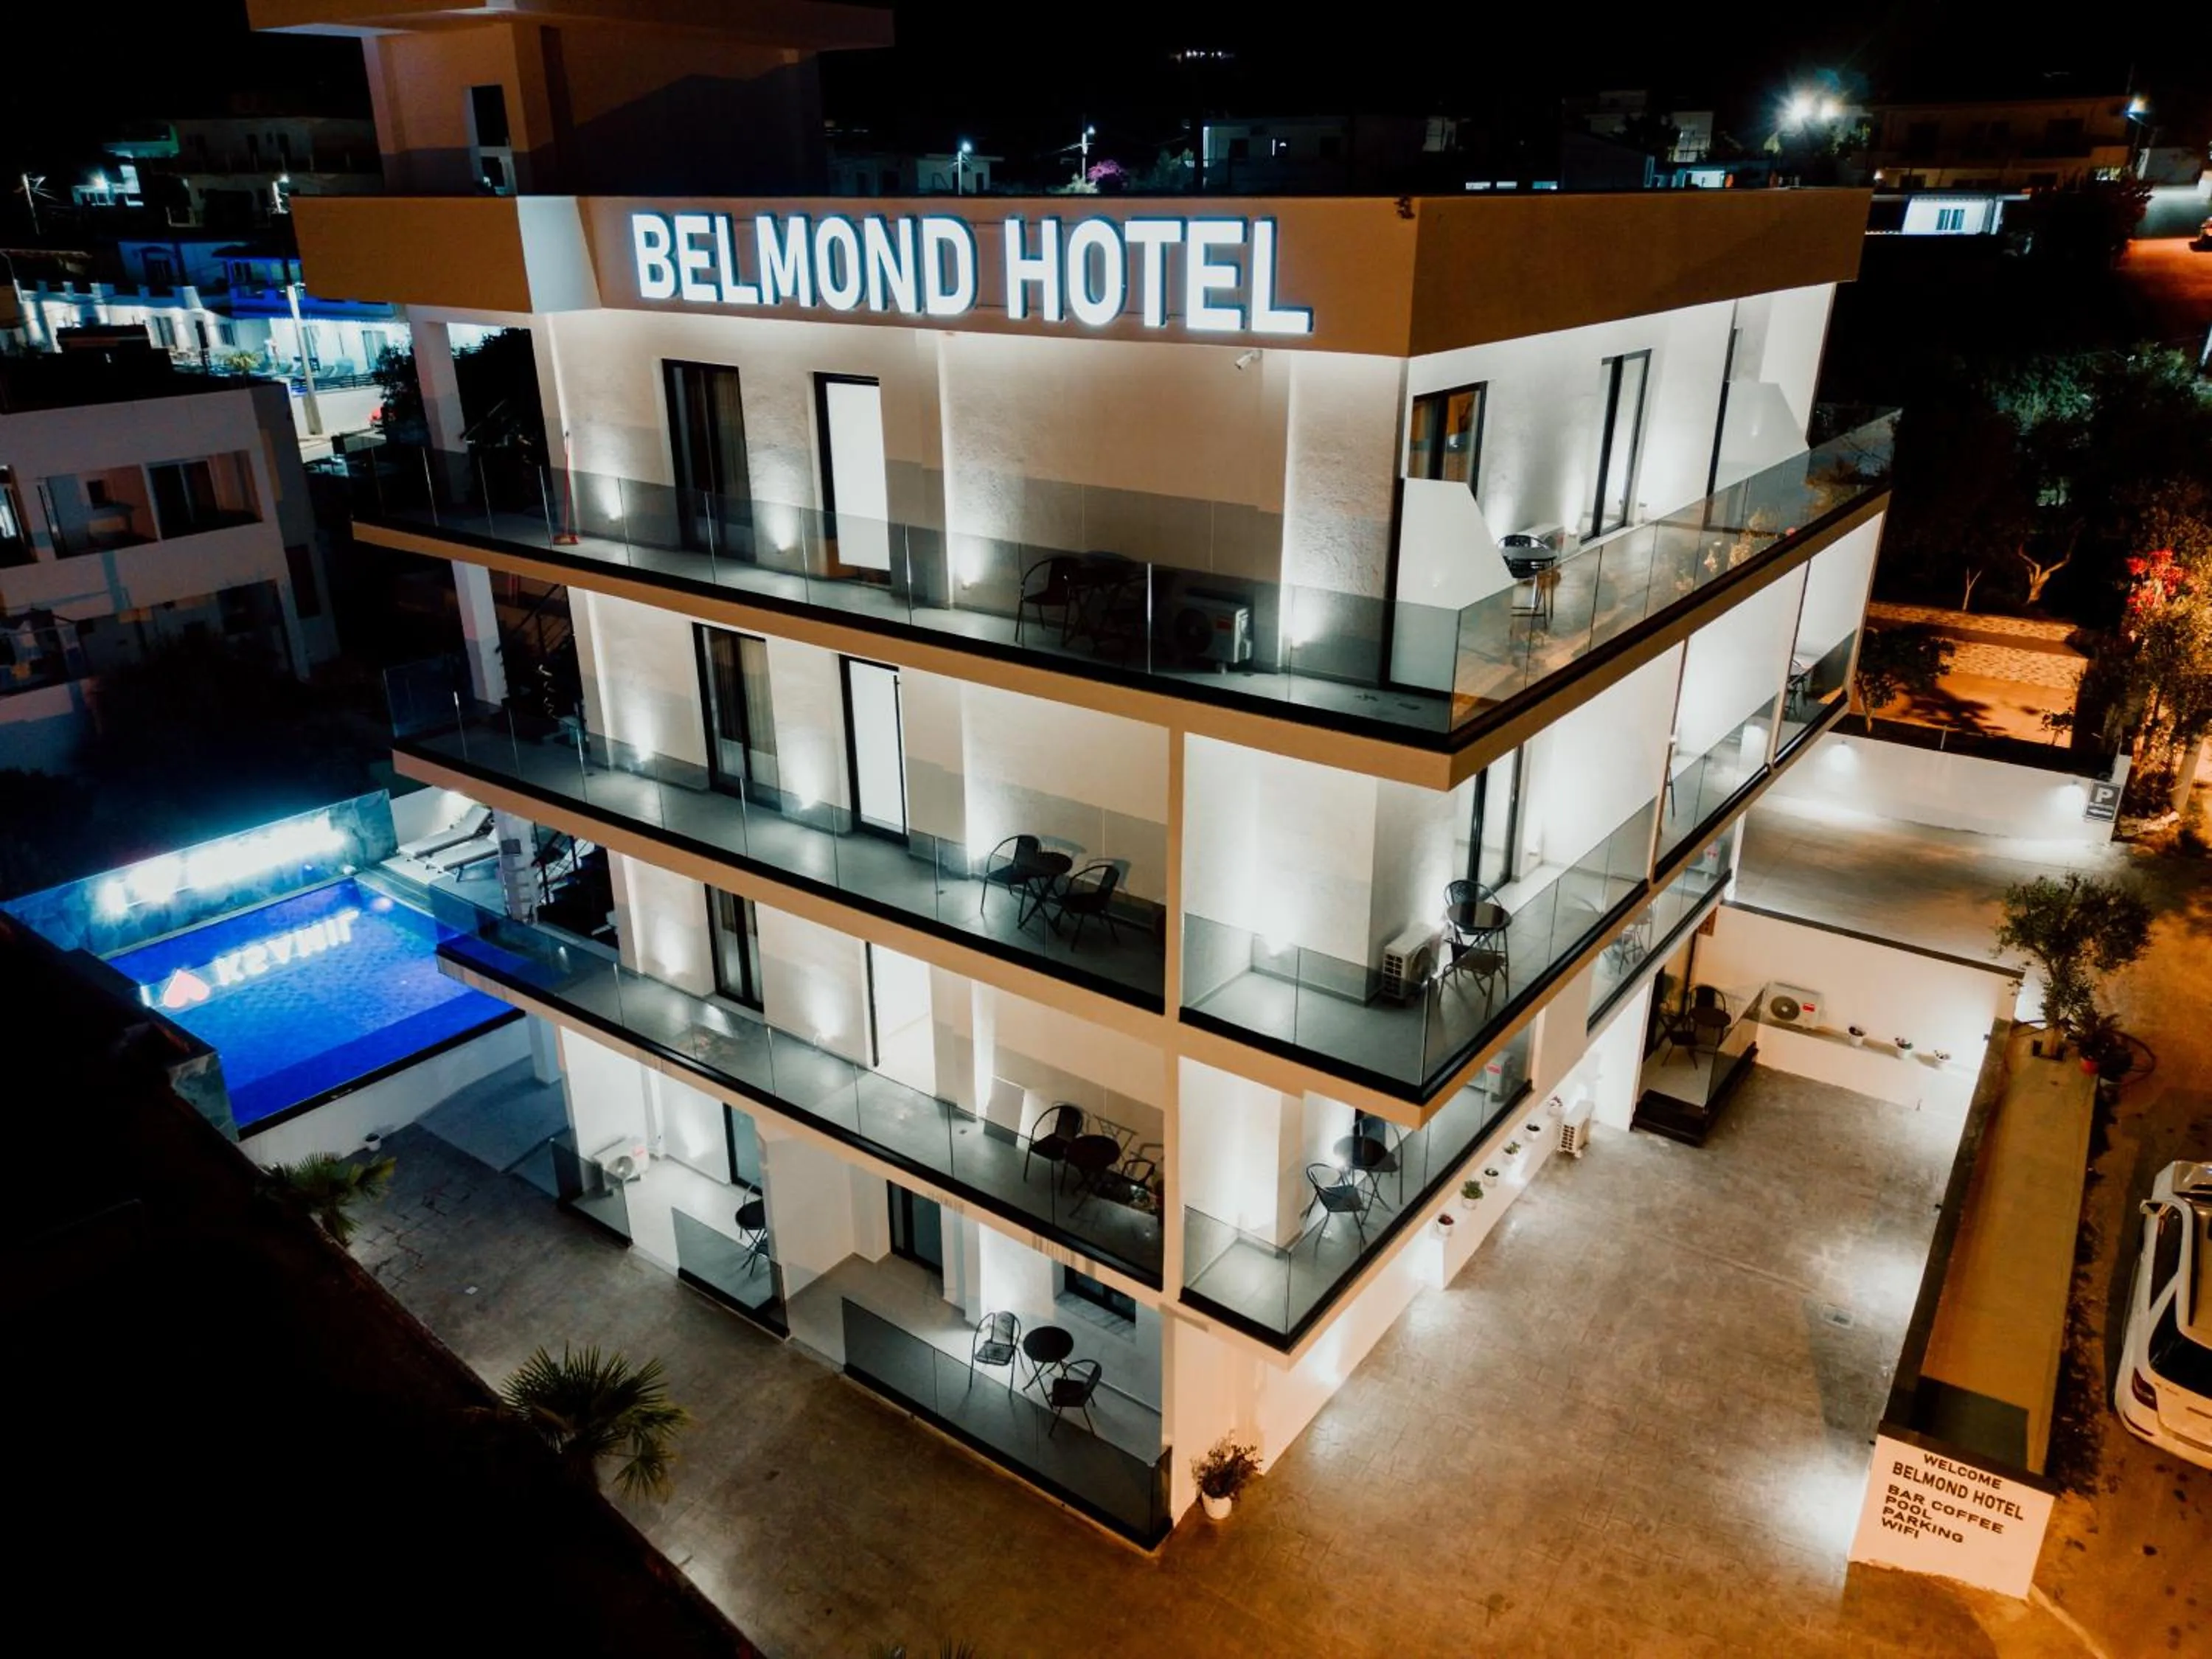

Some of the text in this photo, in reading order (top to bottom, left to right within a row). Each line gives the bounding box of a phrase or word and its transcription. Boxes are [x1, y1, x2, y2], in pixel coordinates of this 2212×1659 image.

[632, 213, 1313, 333] BELMOND HOTEL
[2096, 787, 2114, 803] P
[1924, 1453, 2003, 1490] WELCOME
[1885, 1495, 1933, 1520] POOL
[1888, 1484, 2004, 1534] BAR COFFEE
[1893, 1461, 2024, 1520] BELMOND HOTEL
[1882, 1506, 1964, 1543] PARKING
[1882, 1517, 1919, 1539] WIFI
